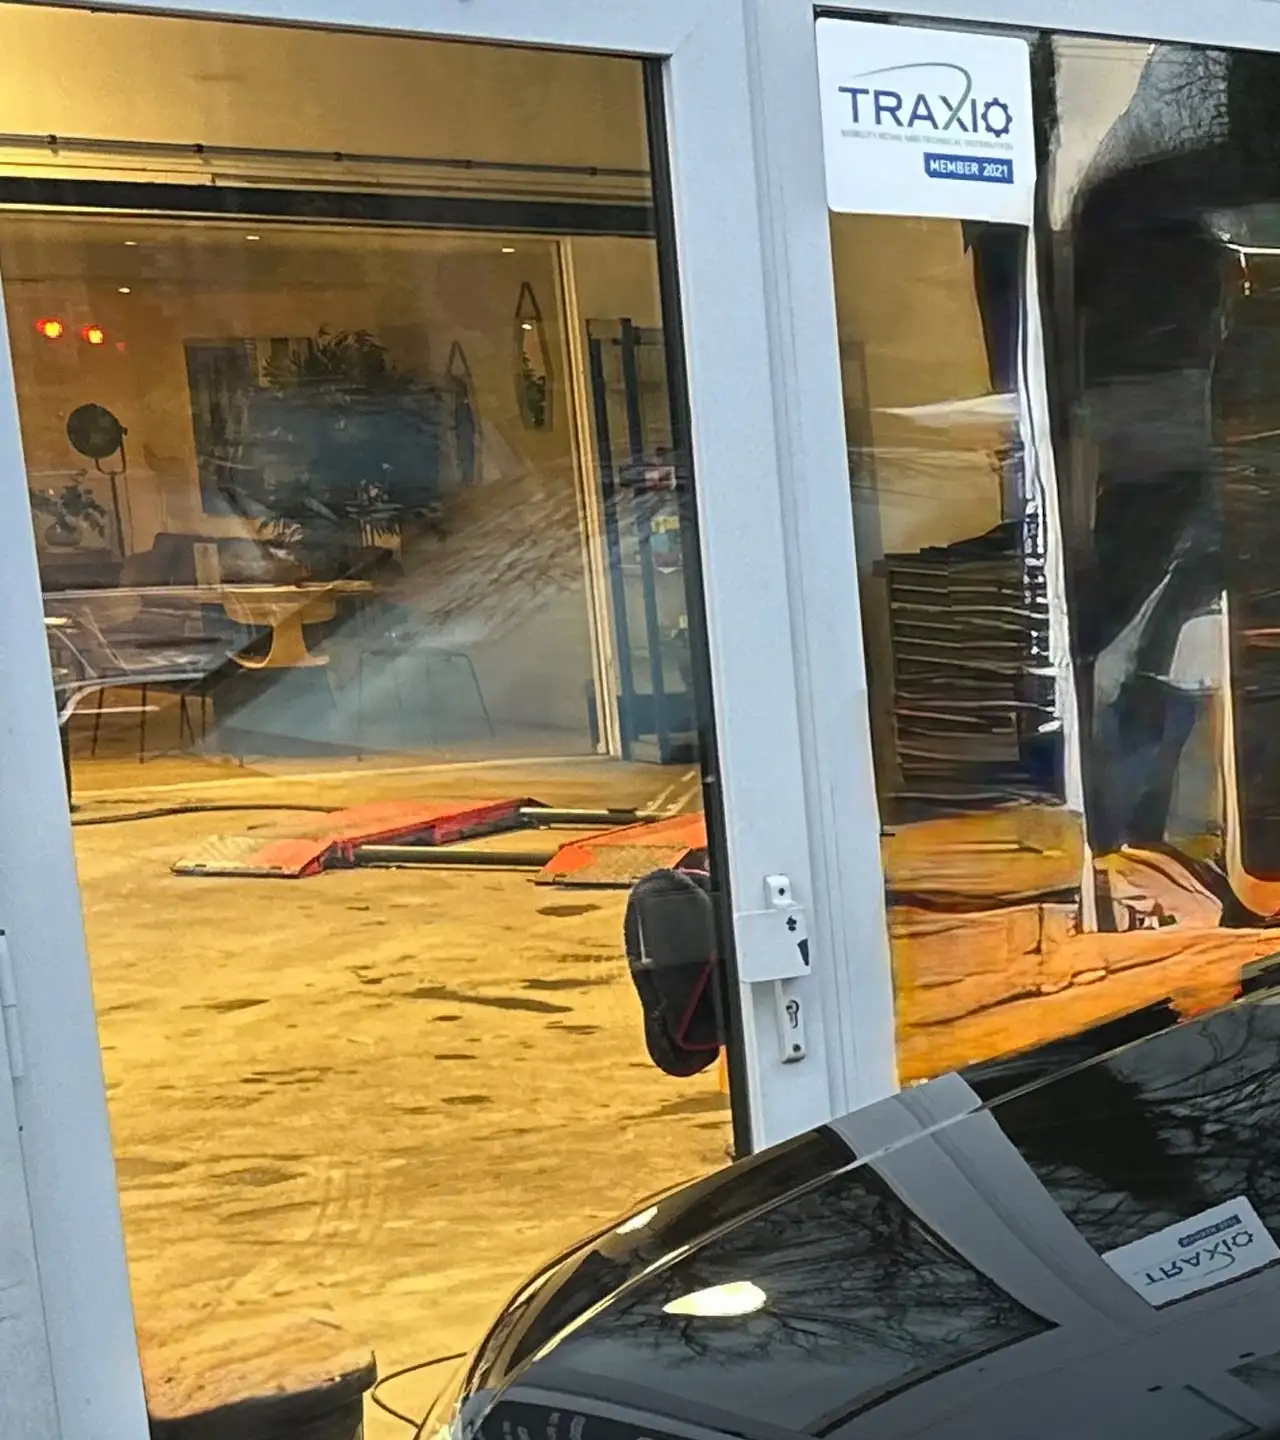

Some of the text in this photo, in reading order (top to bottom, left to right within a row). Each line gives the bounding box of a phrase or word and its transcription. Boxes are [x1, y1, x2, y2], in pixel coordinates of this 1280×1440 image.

[838, 85, 1013, 138] TRAXIO
[929, 159, 1008, 178] MEMBER 2021
